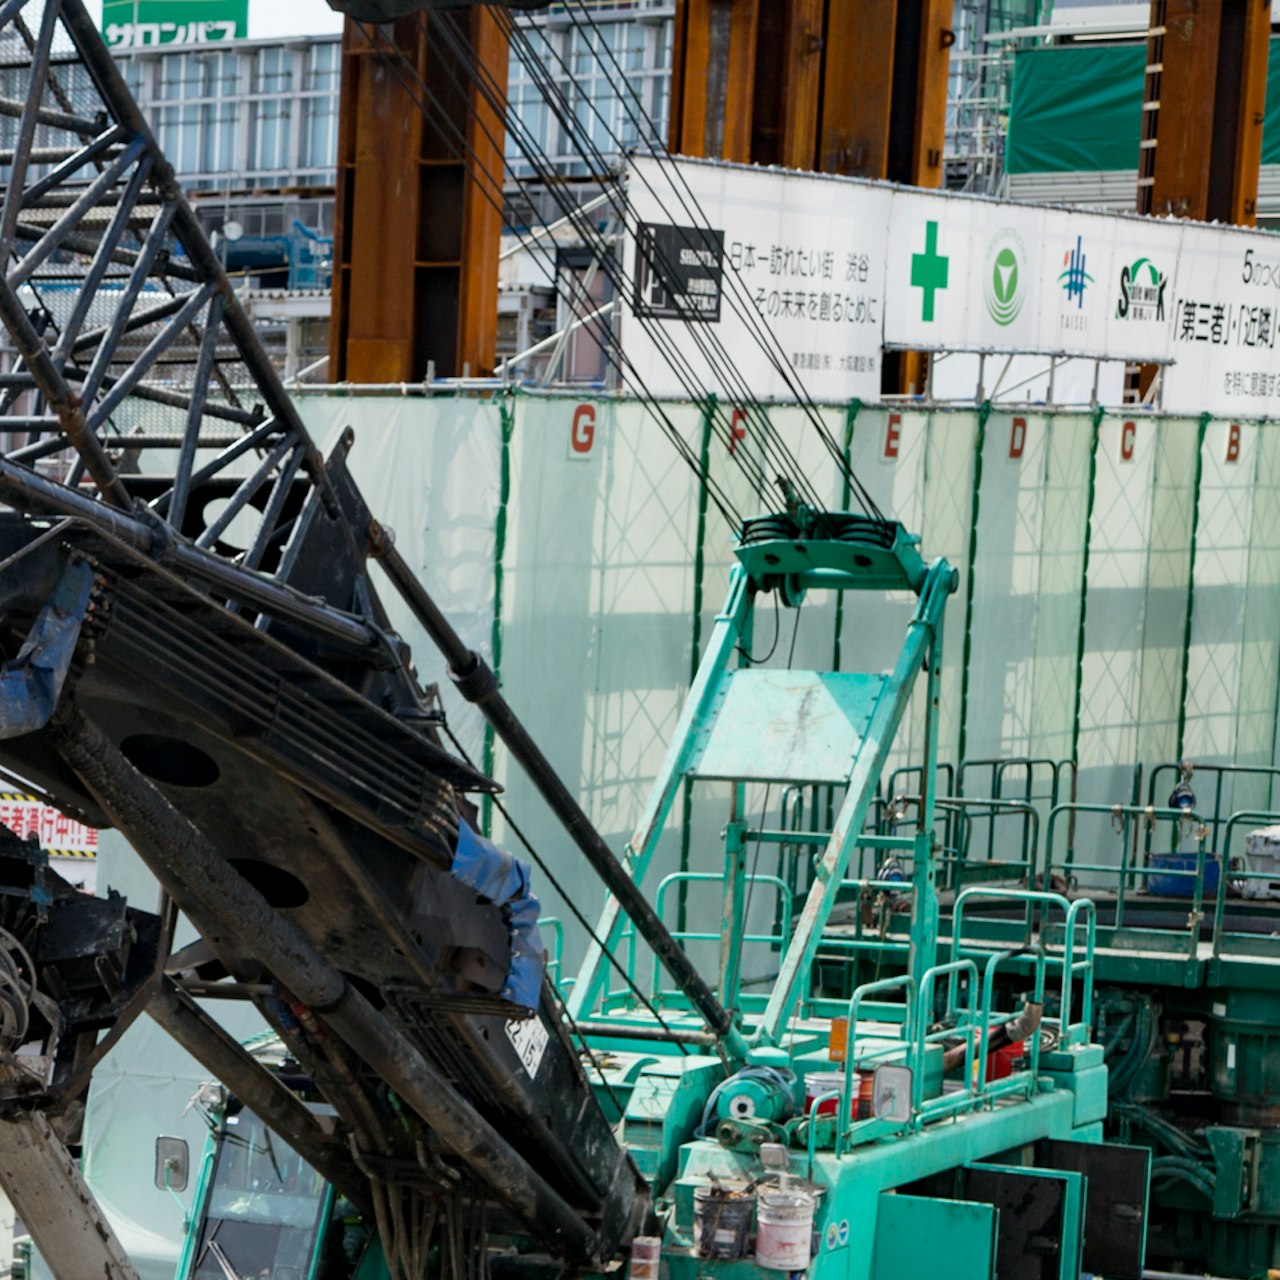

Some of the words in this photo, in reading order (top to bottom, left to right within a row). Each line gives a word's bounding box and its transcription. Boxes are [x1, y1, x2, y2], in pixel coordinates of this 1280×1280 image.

[731, 241, 834, 281] 日本一訪れたい街
[846, 252, 870, 283] 渋谷
[756, 287, 878, 324] その未来を創るために
[1060, 314, 1087, 331] TAISEI
[571, 404, 596, 453] G
[730, 408, 747, 456] F
[884, 413, 901, 458] E
[1009, 417, 1026, 460] D
[1122, 421, 1135, 461] C
[1226, 425, 1240, 462] B
